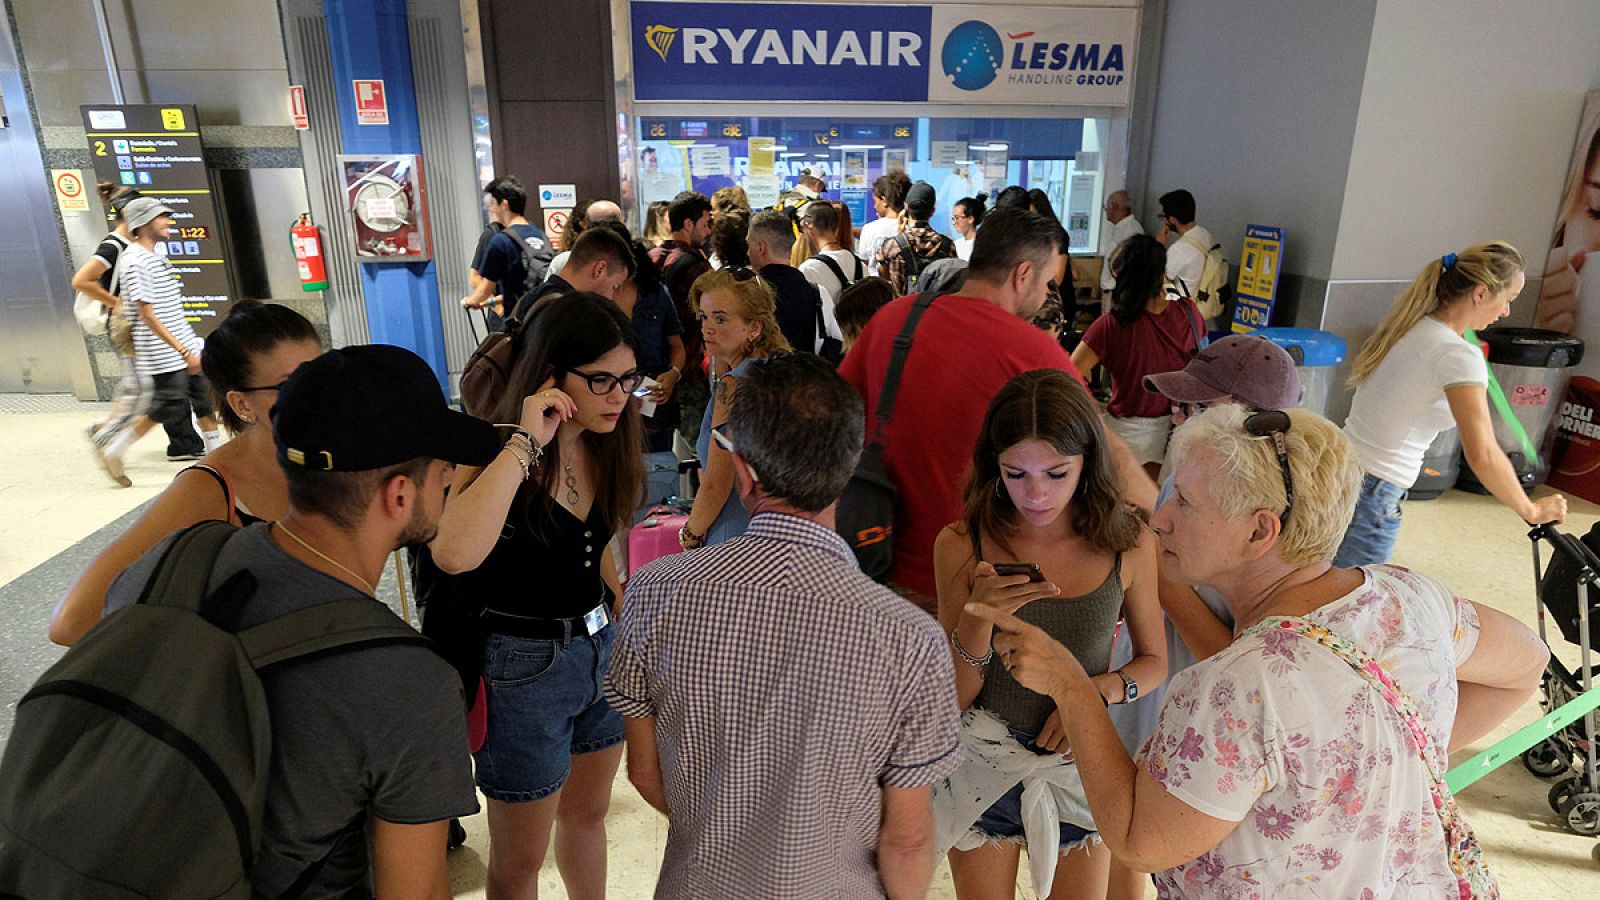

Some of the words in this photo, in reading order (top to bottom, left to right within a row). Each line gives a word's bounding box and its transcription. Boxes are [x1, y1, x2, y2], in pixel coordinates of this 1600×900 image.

[682, 28, 922, 66] RYANAIR
[1011, 42, 1124, 71] LESMA
[1008, 73, 1073, 85] HANDLING
[1076, 74, 1124, 86] GROUP
[94, 141, 108, 156] 2
[181, 227, 206, 238] 1:22
[1563, 400, 1594, 422] DELI
